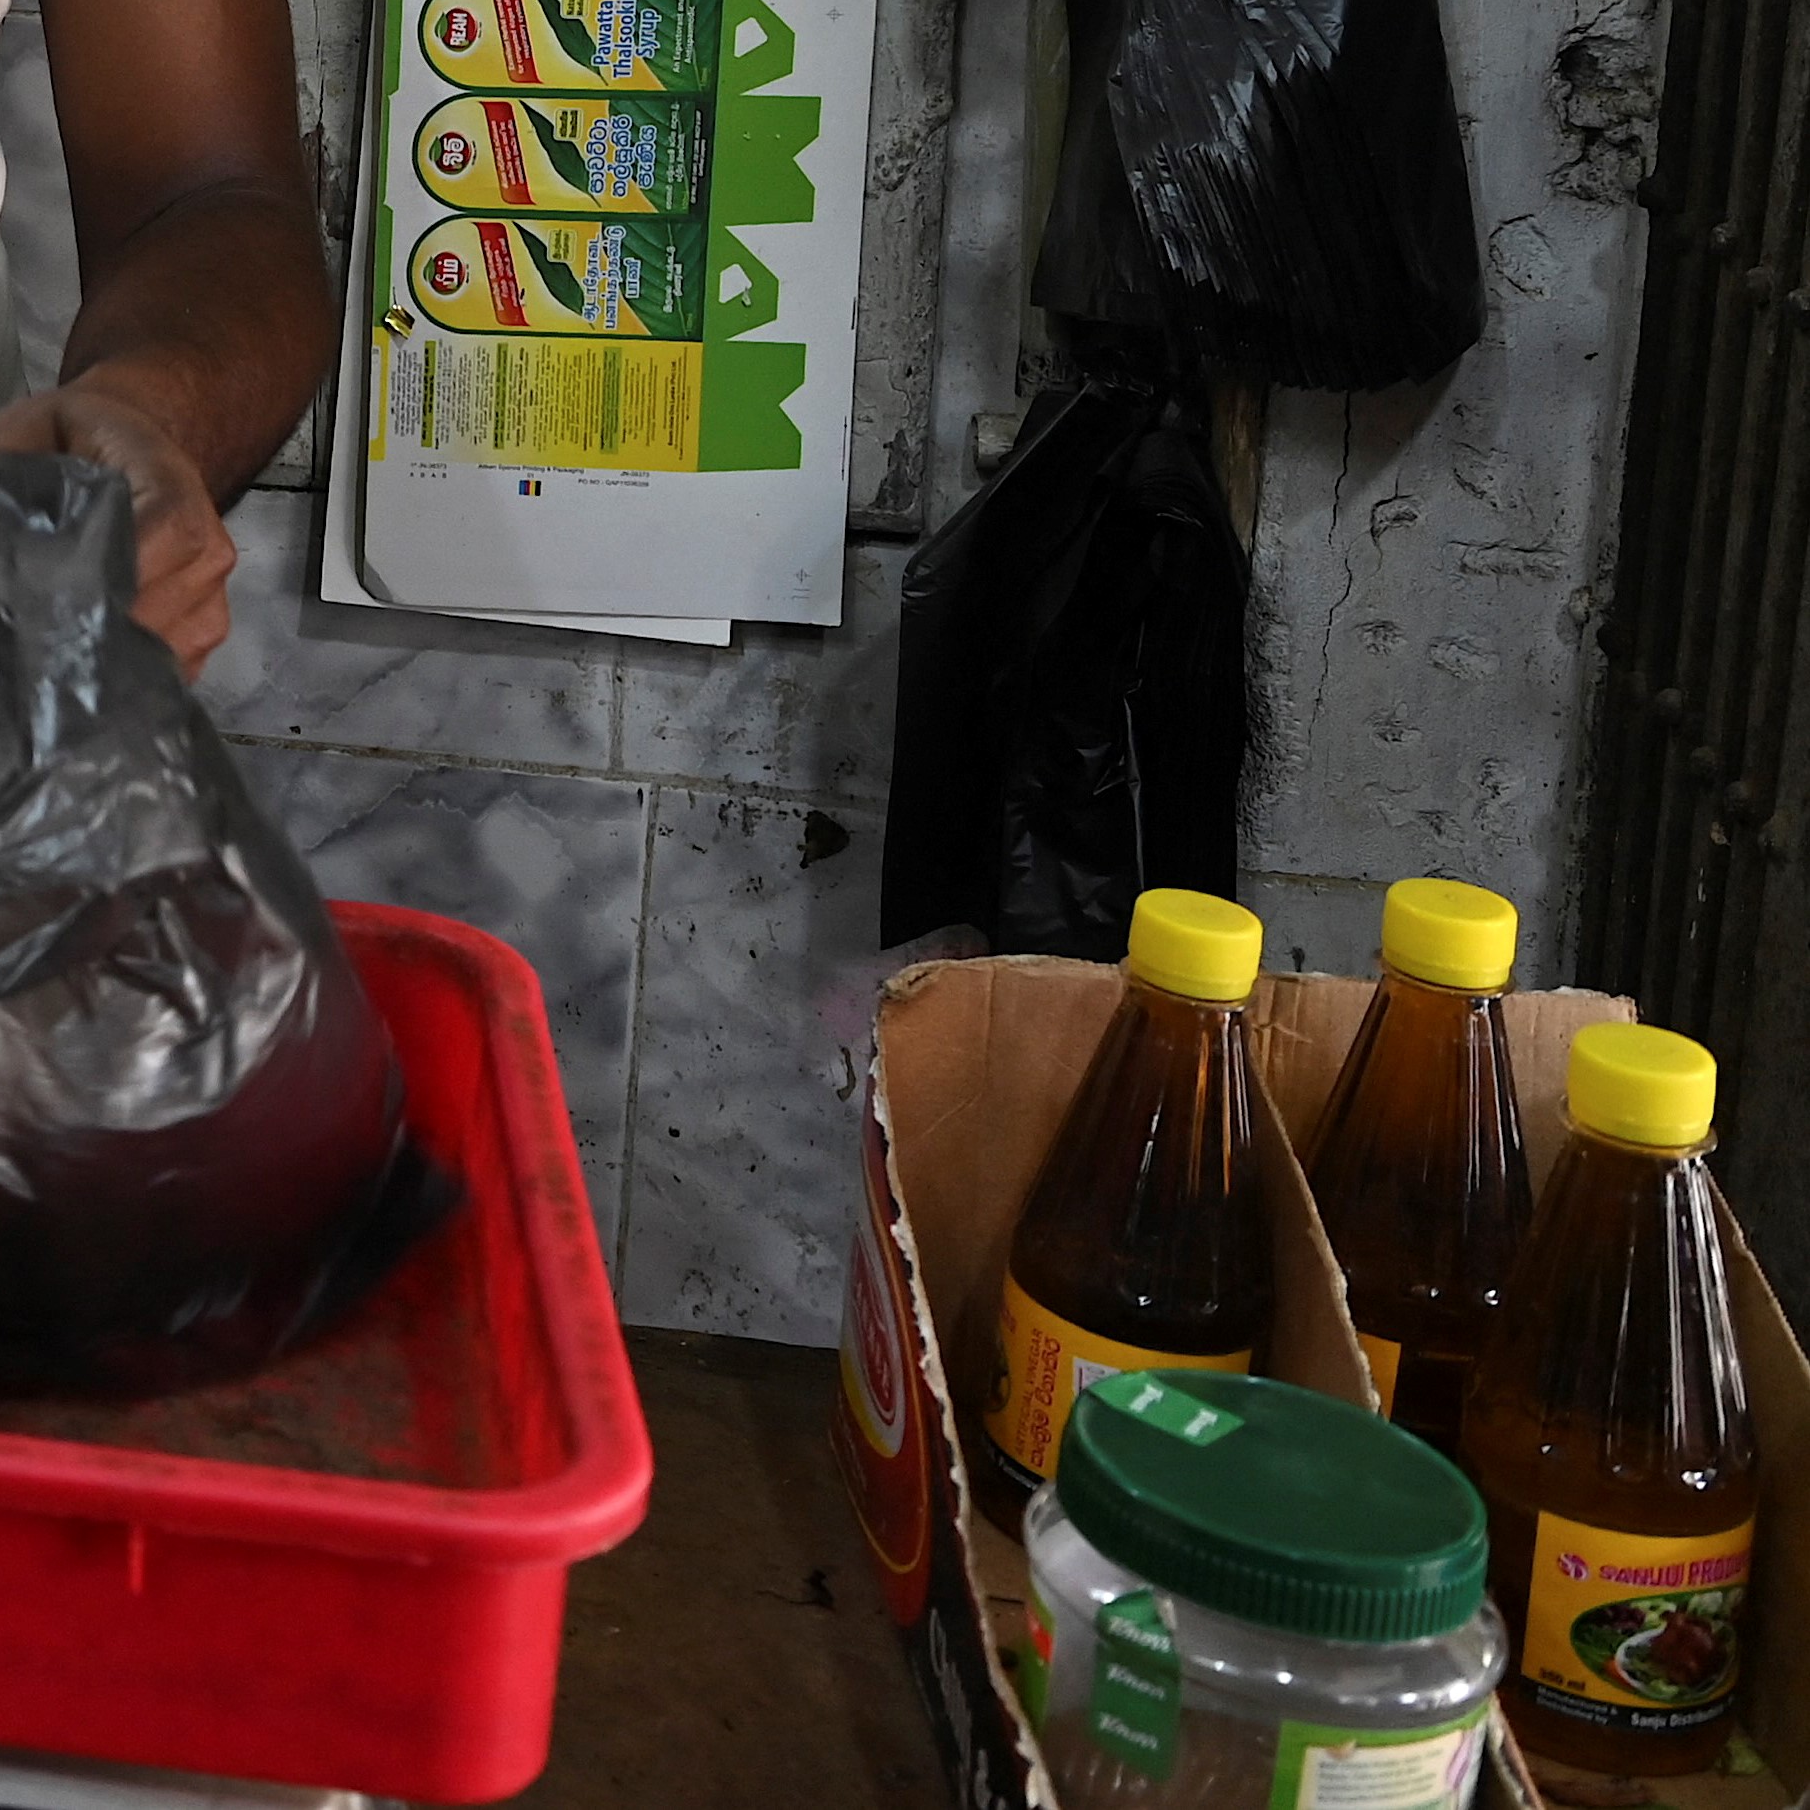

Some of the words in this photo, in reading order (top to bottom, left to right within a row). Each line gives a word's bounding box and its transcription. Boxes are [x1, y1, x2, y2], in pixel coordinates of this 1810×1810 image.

[449, 12, 469, 46] BEAM
[592, 0, 614, 67] Pawatta
[635, 9, 661, 59] Syrup
[1025, 1327, 1044, 1385] VINEGAR
